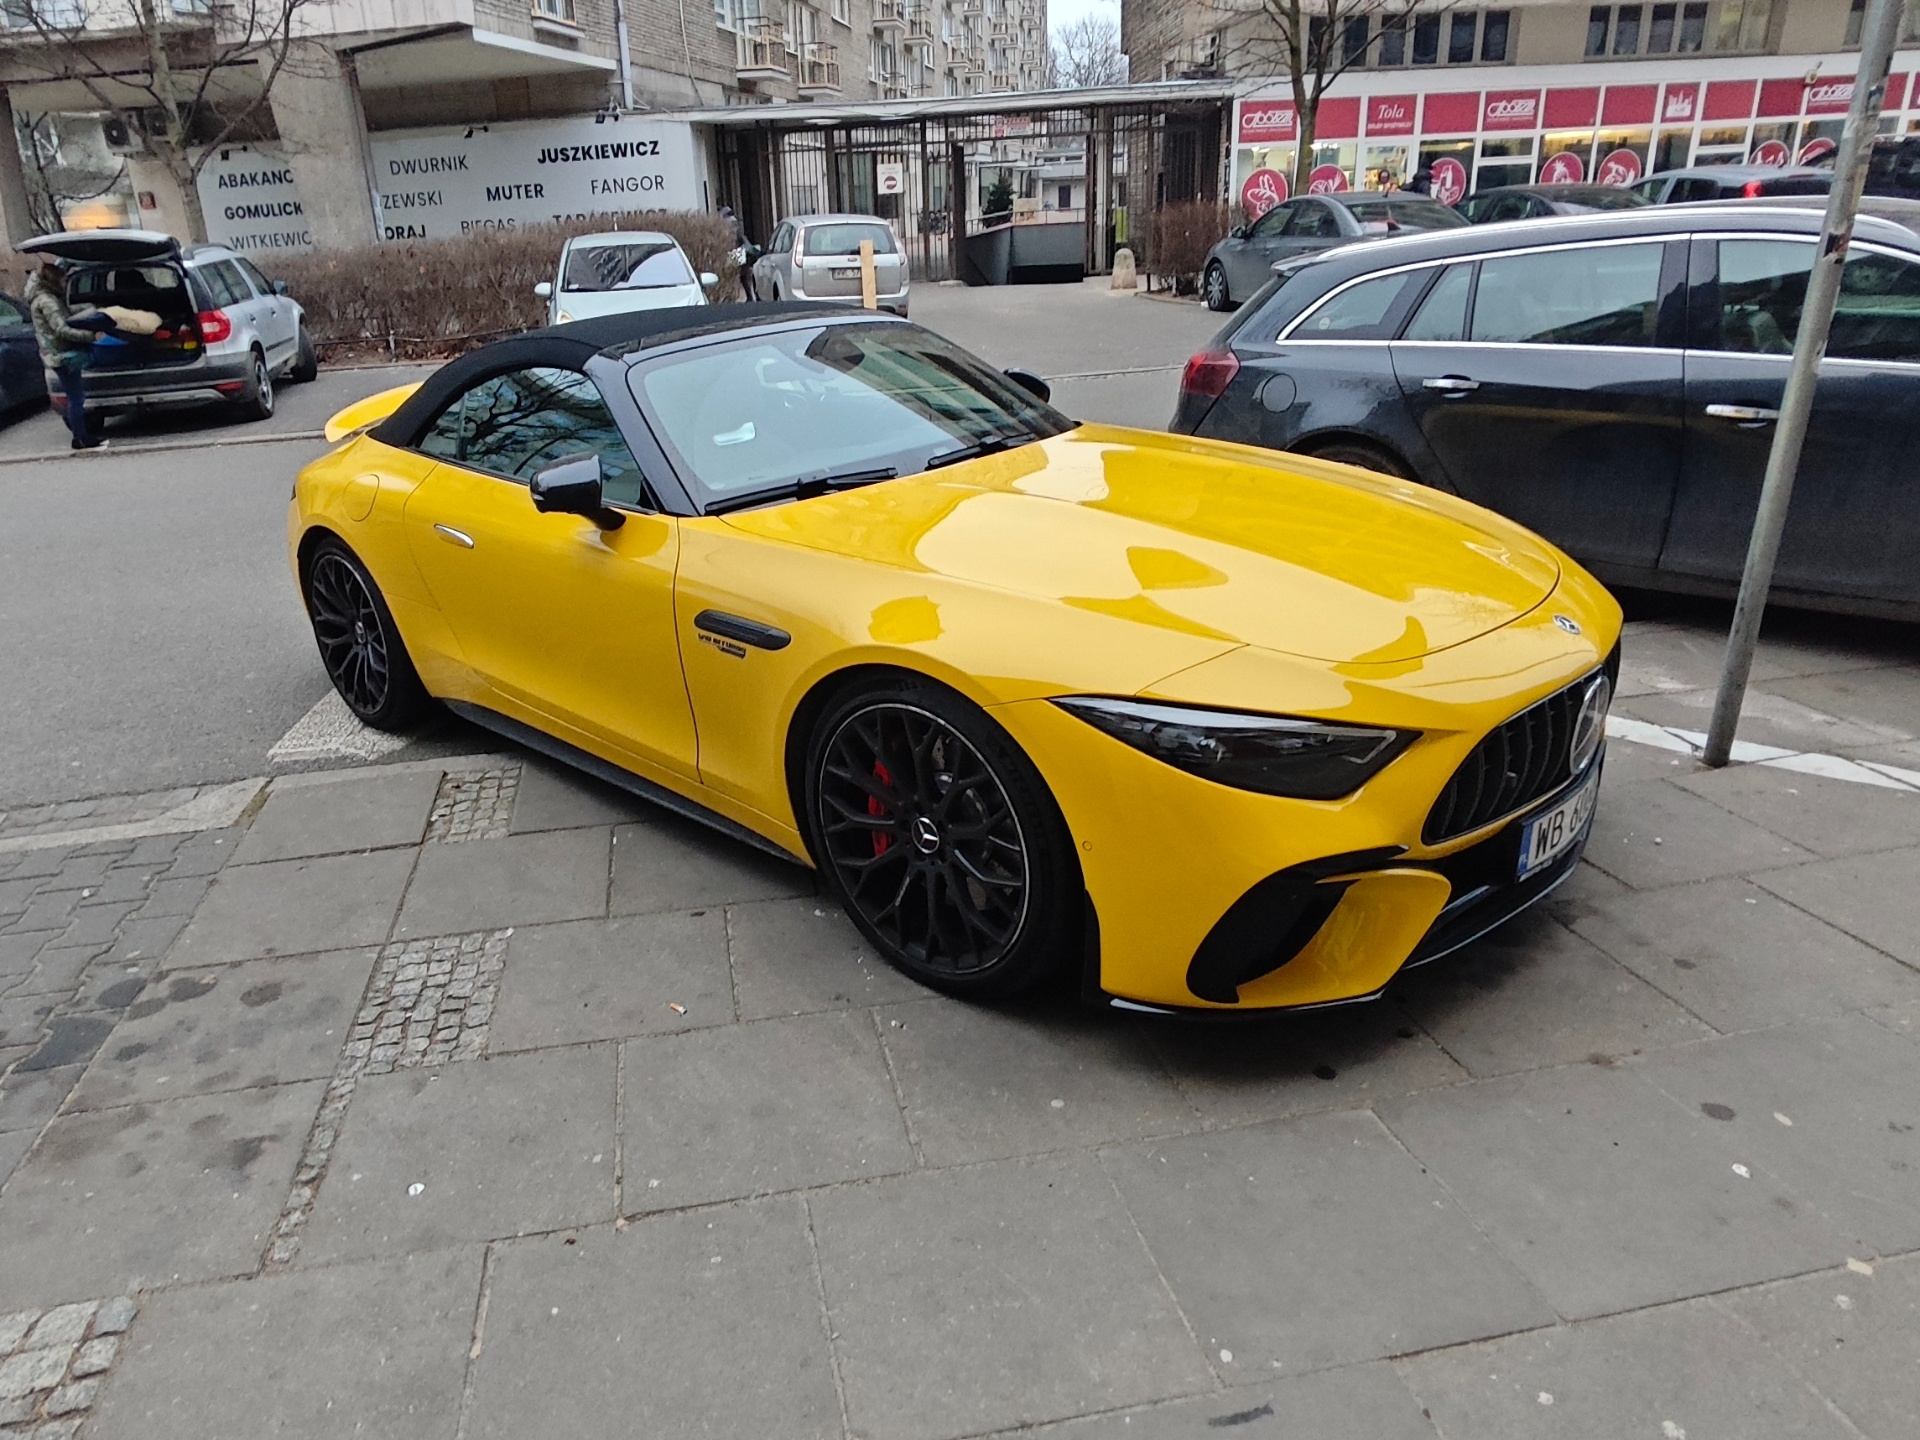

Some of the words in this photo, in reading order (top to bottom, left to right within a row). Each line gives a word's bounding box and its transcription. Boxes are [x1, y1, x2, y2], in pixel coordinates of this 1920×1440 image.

[1378, 104, 1404, 119] Tola
[390, 155, 468, 176] DWURNIK
[537, 140, 660, 164] JUSZKIEWICZ
[382, 190, 443, 210] ZEWSKI
[486, 183, 545, 202] MUTER
[590, 175, 665, 195] FANGOR
[230, 230, 312, 250] WITKIEWIC
[1535, 809, 1565, 860] WB
